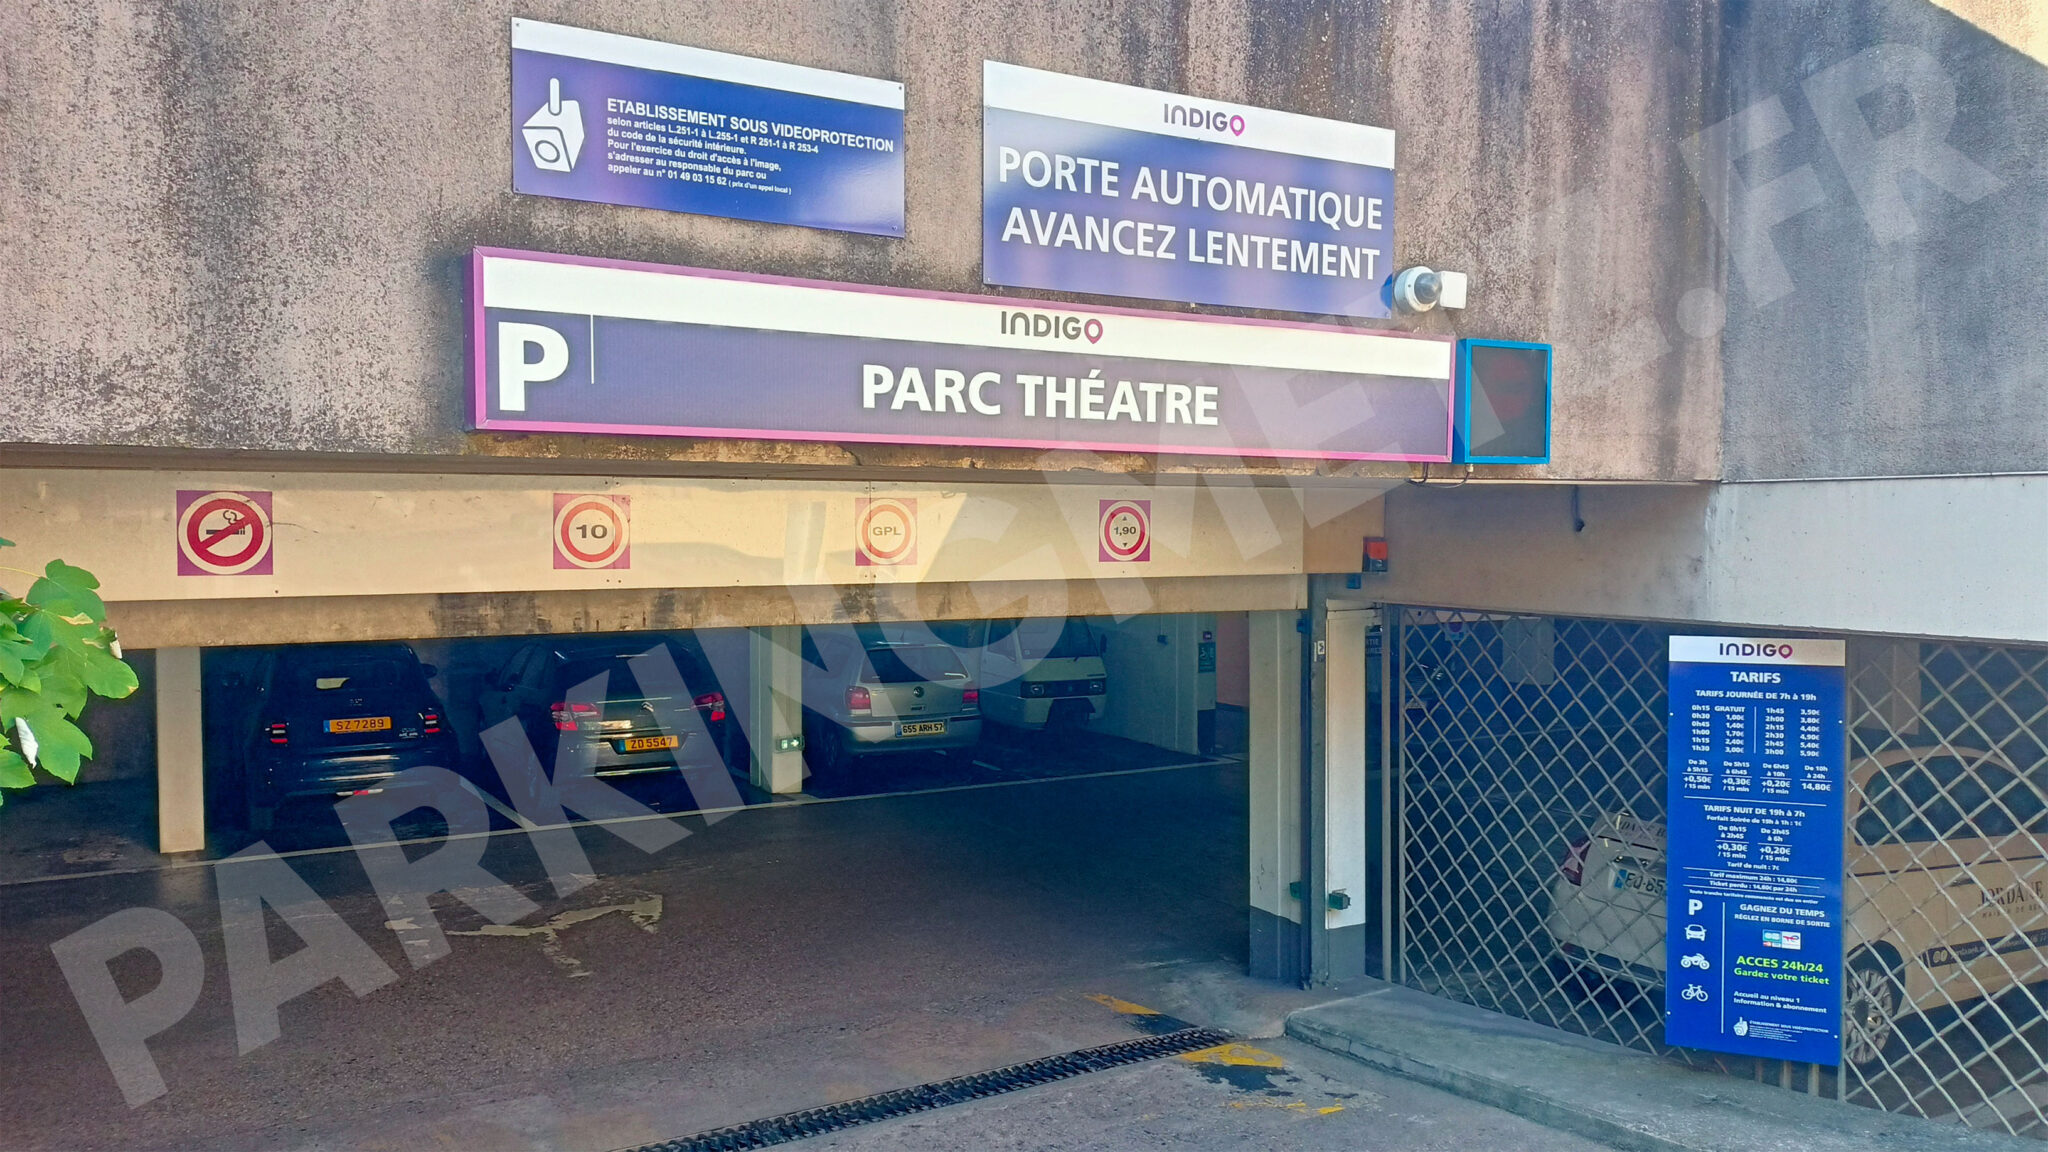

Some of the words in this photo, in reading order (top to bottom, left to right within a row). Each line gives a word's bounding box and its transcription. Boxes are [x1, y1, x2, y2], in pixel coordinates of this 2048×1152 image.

[607, 98, 726, 128] ETABLISSEMENT
[730, 116, 768, 134] SOUS
[771, 122, 894, 152] VIDEOPROTECTION
[1164, 103, 1245, 137] INDIGO
[607, 117, 632, 128] selon
[634, 120, 666, 132] articles
[668, 124, 698, 136] L.251-1
[701, 128, 707, 138] à
[740, 135, 749, 144] et
[750, 136, 757, 145] R
[759, 137, 780, 148] 251-1
[782, 140, 788, 149] à
[789, 141, 796, 151] R
[797, 144, 819, 154] 253-4
[607, 128, 619, 137] du
[622, 130, 643, 140] code
[646, 133, 656, 142] de
[659, 134, 666, 144] la
[668, 136, 702, 148] sécurité
[704, 140, 747, 154] intérieure.
[608, 139, 629, 150] Pour
[631, 142, 672, 156] l'exercice
[674, 148, 686, 158] du
[688, 150, 708, 161] droit
[710, 152, 741, 165] d'accès
[744, 157, 749, 166] à
[751, 158, 782, 172] l'image,
[608, 152, 653, 164] s'adresser
[656, 158, 667, 167] au
[669, 160, 721, 174] responsable
[723, 166, 734, 175] du
[736, 169, 754, 178] parc
[756, 172, 767, 180] ou
[608, 164, 642, 175] appeler
[644, 168, 654, 177] au
[668, 170, 678, 179] 01
[680, 172, 691, 181] 49
[692, 173, 703, 183] 03
[705, 175, 715, 184] 15
[717, 176, 727, 186] 62
[732, 180, 744, 188] prix
[999, 146, 1119, 197] PORTE
[1131, 166, 1383, 231] AUTOMATIQUE
[1001, 207, 1176, 260] AVANCEZ
[1188, 228, 1380, 280] LENTEMENT
[1001, 310, 1103, 344] INDIGO
[498, 321, 569, 411] P
[863, 364, 1001, 416] PARC
[1016, 369, 1218, 426] THÉATRE
[576, 524, 608, 539] 10
[872, 526, 901, 536] GPL
[1114, 526, 1137, 536] 1,90
[1720, 642, 1793, 659] INDIGO
[1730, 671, 1781, 684] TARIFS
[1696, 690, 1724, 698] TARIFS
[1725, 690, 1764, 699] JOURNÉE
[1766, 692, 1778, 700] DE
[336, 721, 350, 730] SZ
[355, 719, 384, 729] 7289
[902, 725, 917, 733] 655
[919, 724, 932, 732] ARH
[934, 723, 943, 731] 57
[631, 739, 644, 749] ZD
[646, 737, 672, 748] 5547
[1684, 776, 1712, 784] +0,50€
[1722, 778, 1751, 786] +0,30€
[1762, 780, 1791, 788] +0,20€
[1802, 783, 1831, 792] 14,80€
[1704, 805, 1732, 813] TARIFS
[1794, 810, 1806, 818] 7h
[1717, 843, 1748, 852] +0,30€
[1760, 846, 1791, 856] +0,20€
[1688, 899, 1703, 916] P
[1740, 904, 1778, 914] GAGNEZ
[1779, 907, 1793, 915] DU
[1795, 909, 1825, 918] TEMPS
[1734, 914, 1759, 922] RÉGLEZ
[1807, 920, 1830, 928] SORTIE
[1736, 956, 1779, 968] ACCES
[1782, 960, 1824, 973] 24h/24
[1734, 967, 1769, 979] Gardez
[1771, 972, 1798, 982] votre
[1801, 975, 1830, 985] ticket
[1734, 991, 1759, 999] Accueil
[1770, 995, 1794, 1003] niveau
[1734, 998, 1774, 1008] Information
[1783, 1004, 1827, 1014] abonnement
